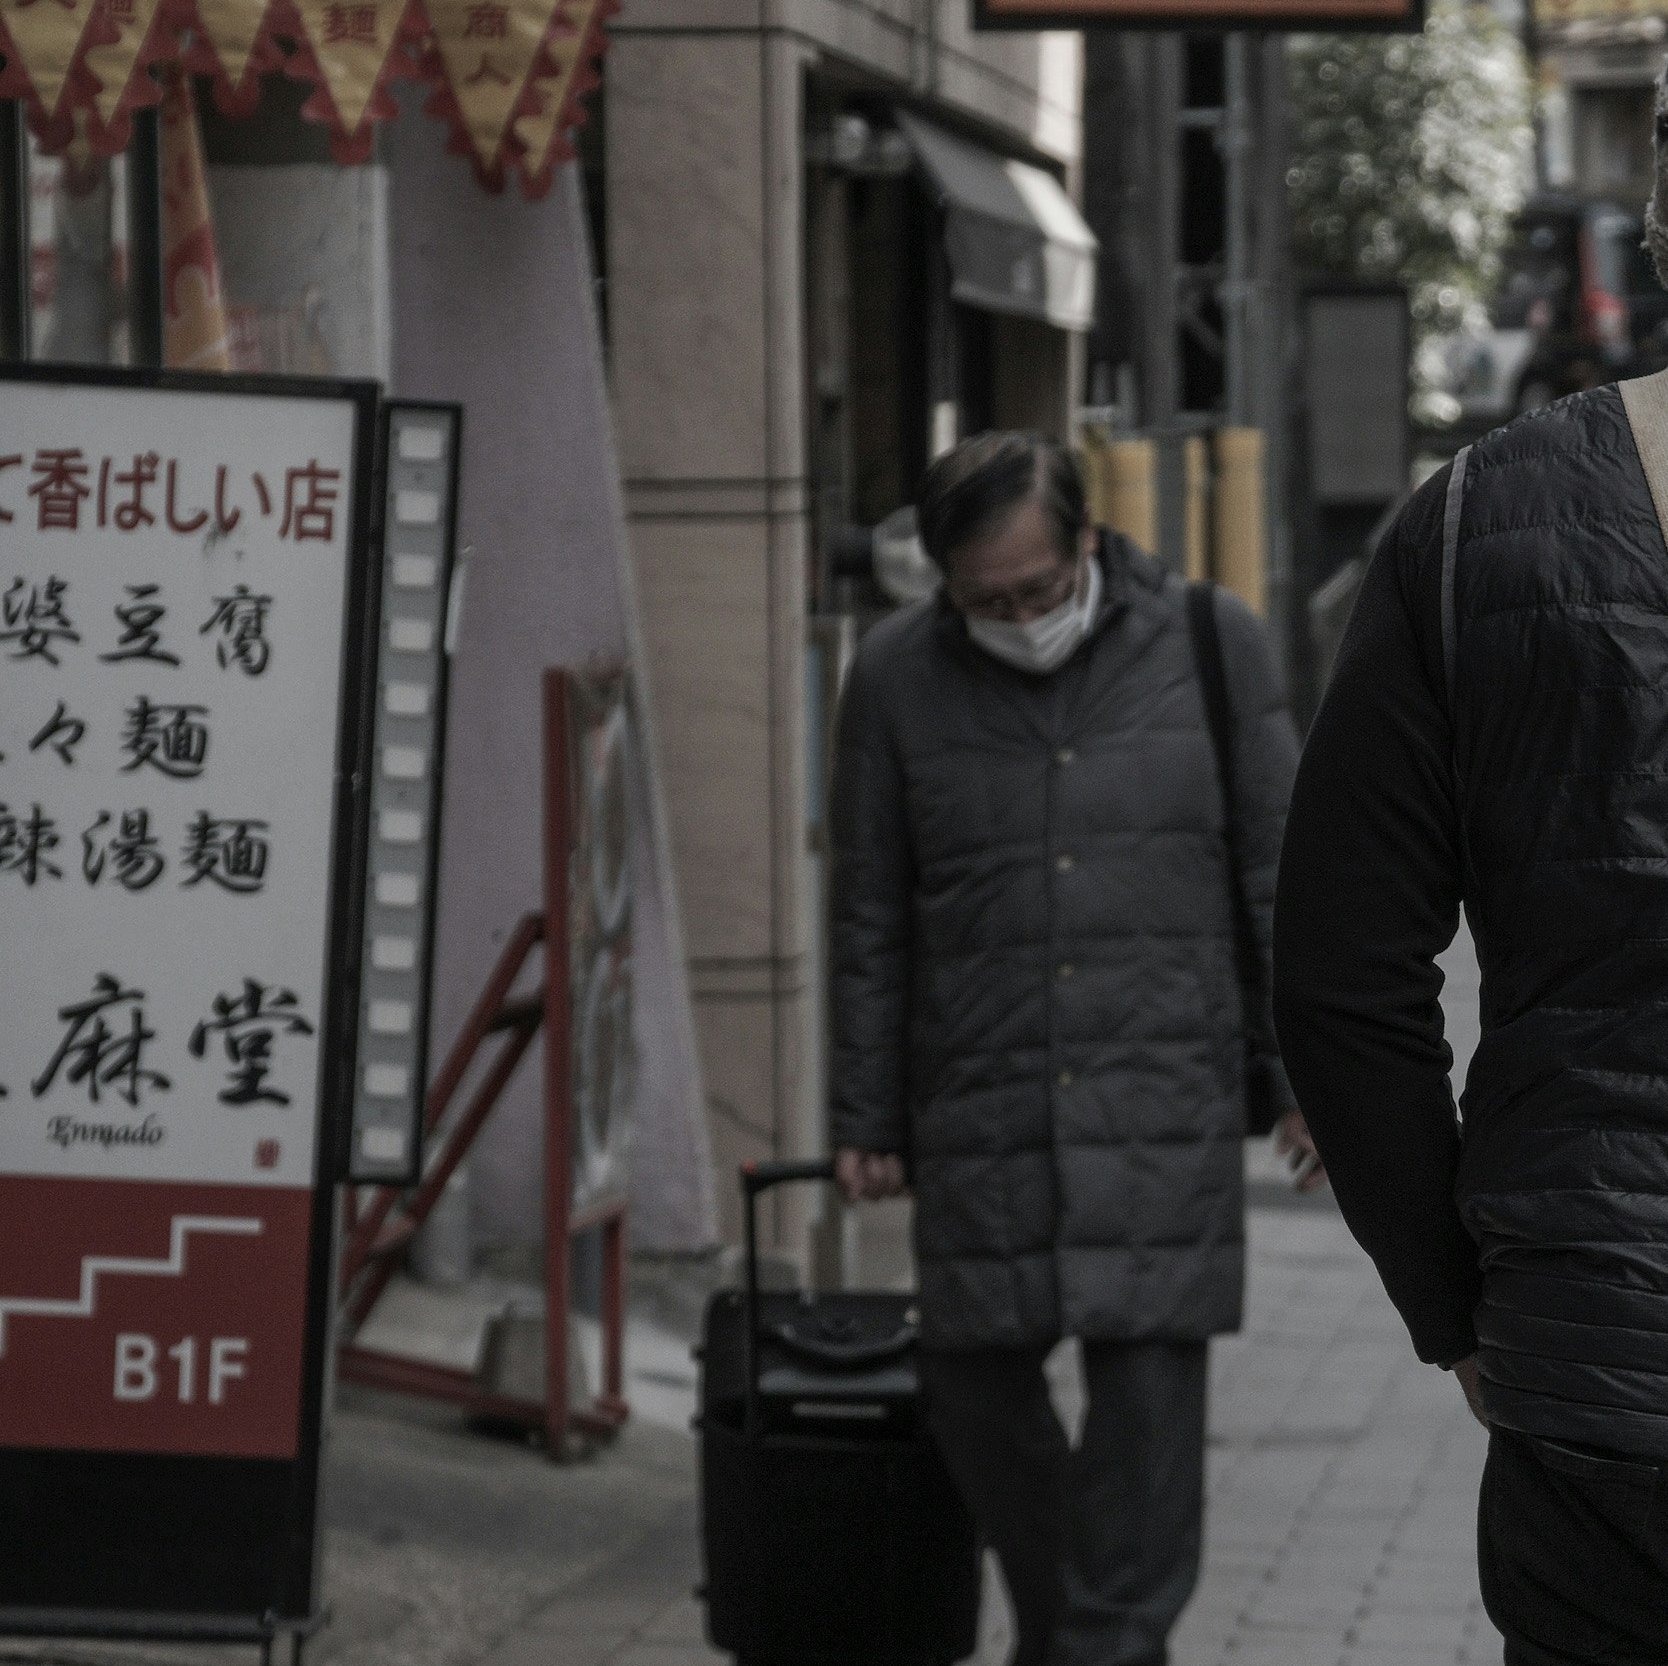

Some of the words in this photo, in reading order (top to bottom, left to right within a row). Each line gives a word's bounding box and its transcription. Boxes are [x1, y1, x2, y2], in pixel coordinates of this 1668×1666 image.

[0, 971, 314, 1106] 麻堂
[47, 1112, 163, 1148] Enmado
[112, 1332, 250, 1405] B1F
